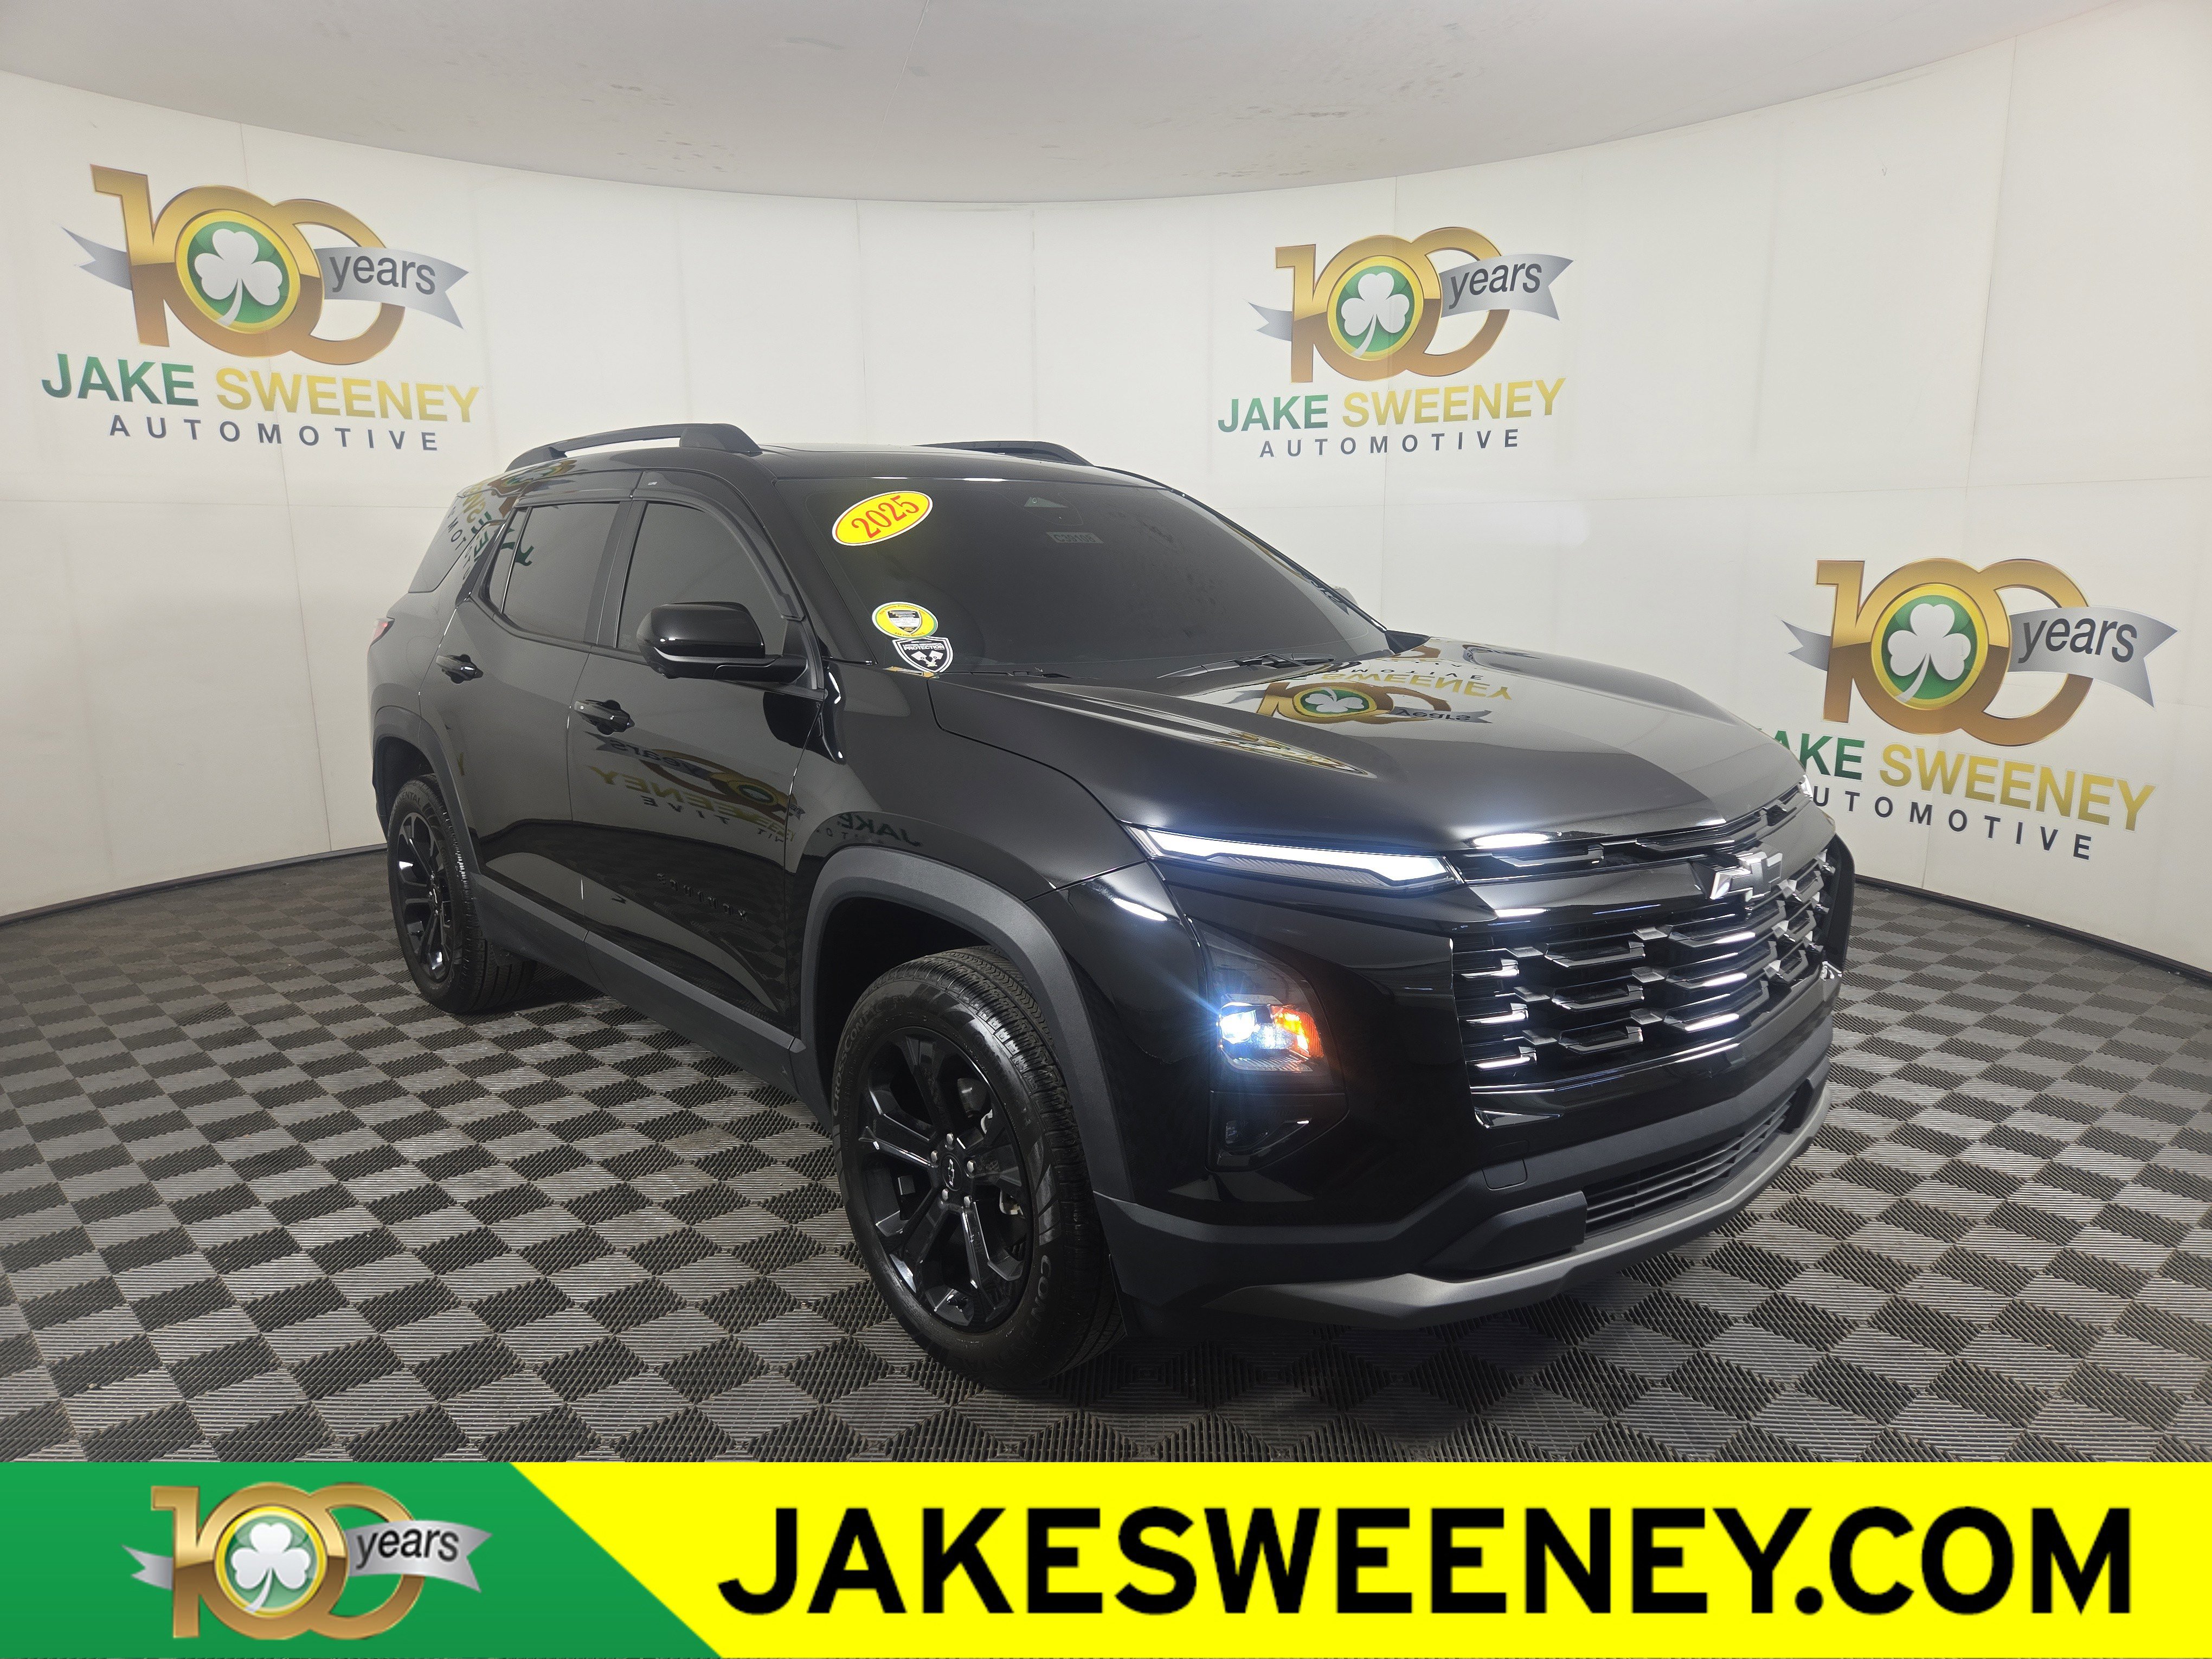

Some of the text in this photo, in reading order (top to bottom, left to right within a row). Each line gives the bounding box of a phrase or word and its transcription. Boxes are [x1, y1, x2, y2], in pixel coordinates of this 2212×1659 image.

[89, 164, 436, 365] 100 years
[1275, 226, 1542, 383] 100 years
[41, 353, 481, 423] JAKE SWEENEY
[1218, 378, 1566, 433] JAKE SWEENEY
[109, 414, 438, 452] AUTOMOTIVE
[1259, 428, 1519, 458] AUTOMOTIVE
[851, 495, 919, 538] 2025
[1816, 557, 2137, 747] 100 years
[1773, 730, 2156, 832] KE SWEENEY
[1813, 786, 2092, 861] UTOMOTIVE
